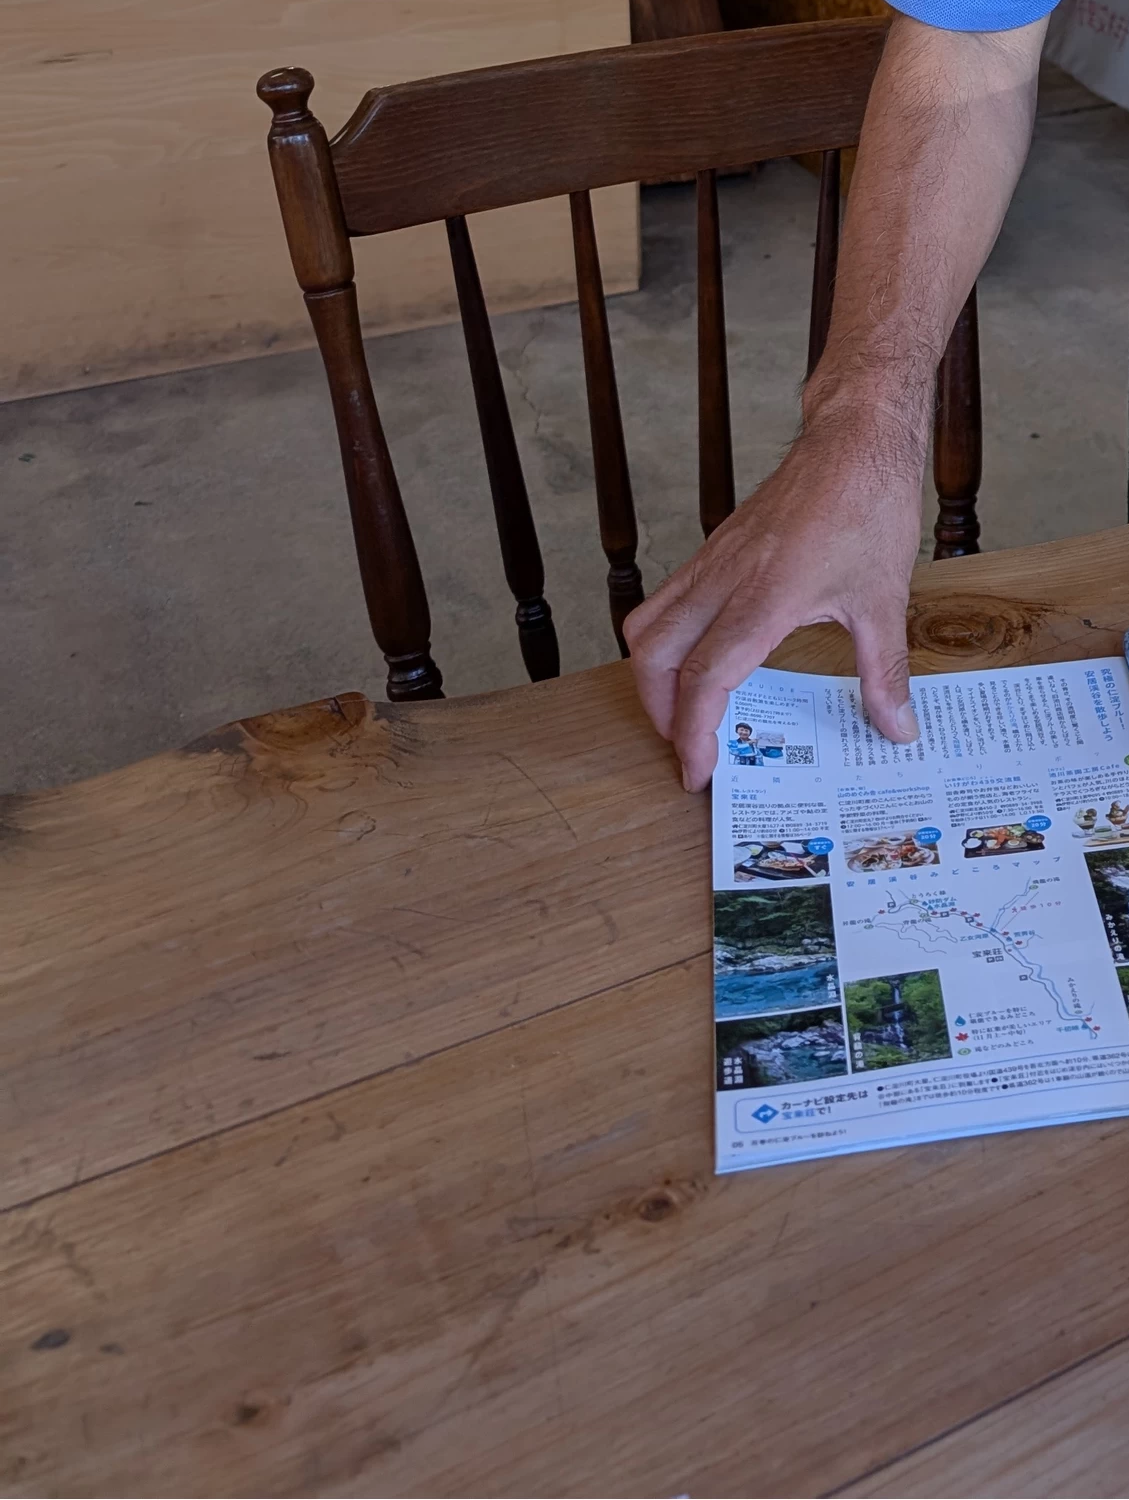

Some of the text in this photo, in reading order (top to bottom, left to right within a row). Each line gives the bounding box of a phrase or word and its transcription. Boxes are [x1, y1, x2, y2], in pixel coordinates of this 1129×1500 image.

[781, 1090, 868, 1110] カーナビ設定先は
